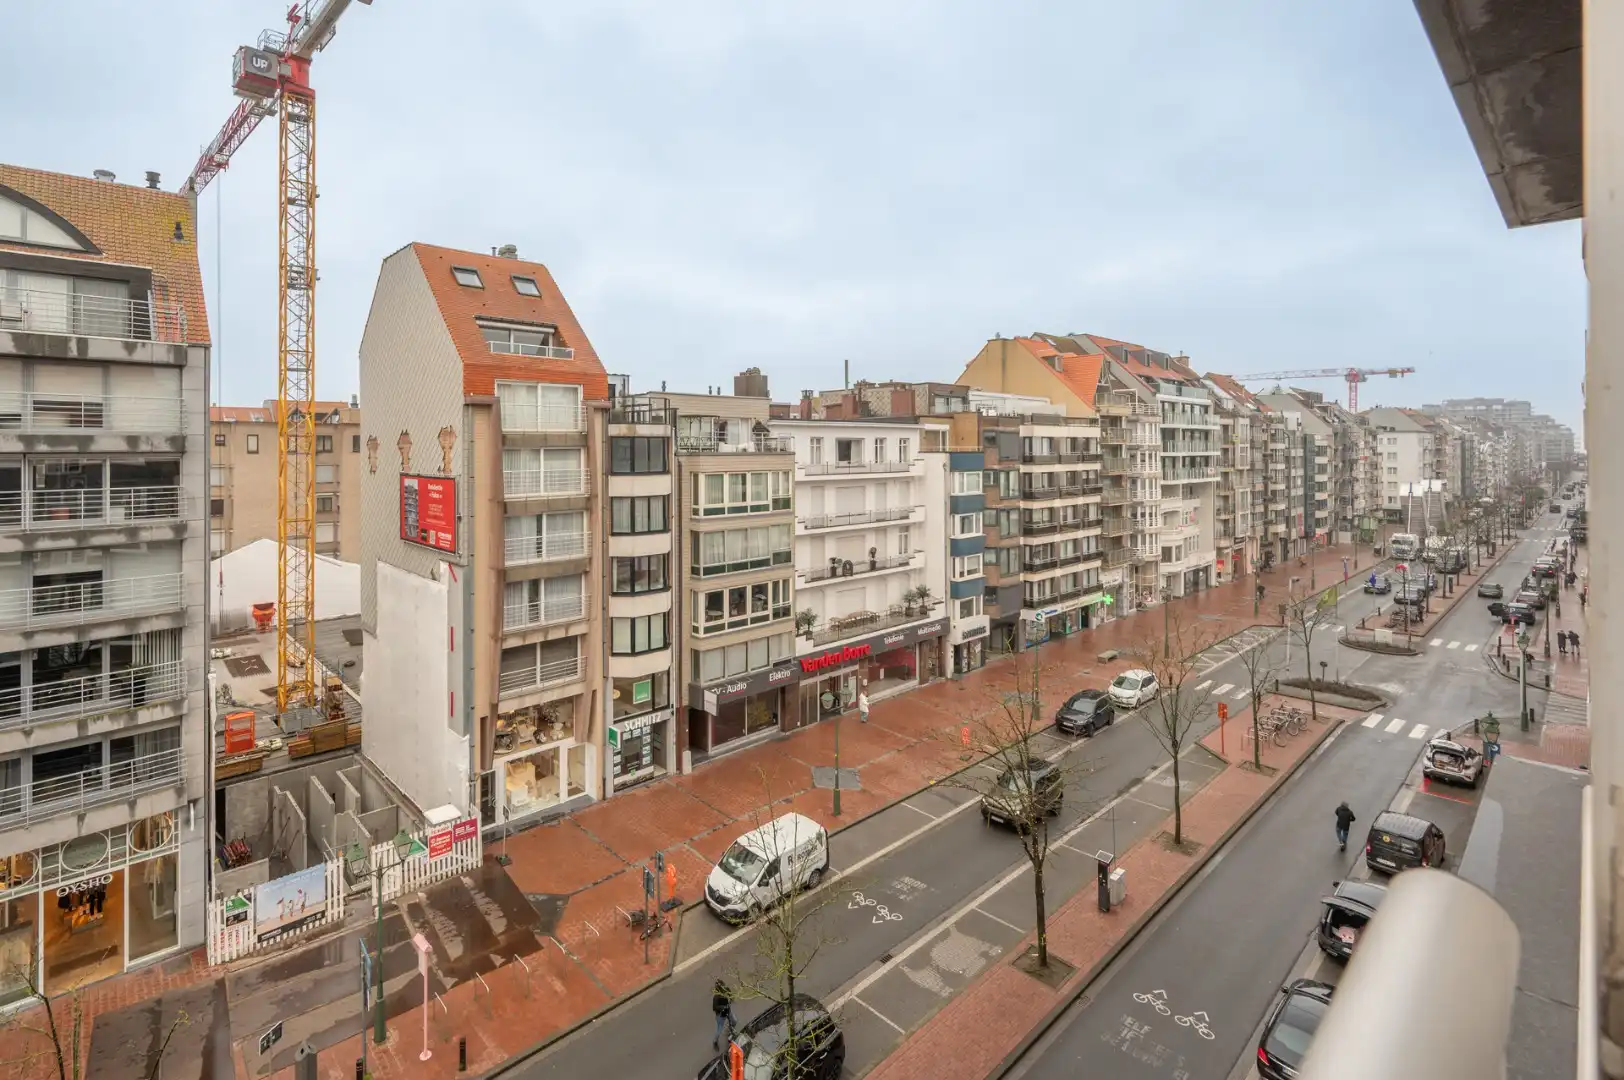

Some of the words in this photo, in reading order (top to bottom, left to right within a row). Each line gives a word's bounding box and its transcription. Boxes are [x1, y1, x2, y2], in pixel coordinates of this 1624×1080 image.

[252, 56, 268, 69] UP
[800, 650, 842, 673] Vanden
[843, 643, 872, 662] Borre
[726, 681, 747, 695] Audio
[769, 669, 791, 682] Elektro
[624, 711, 662, 732] SCHMITZ
[56, 873, 113, 898] OYSHO
